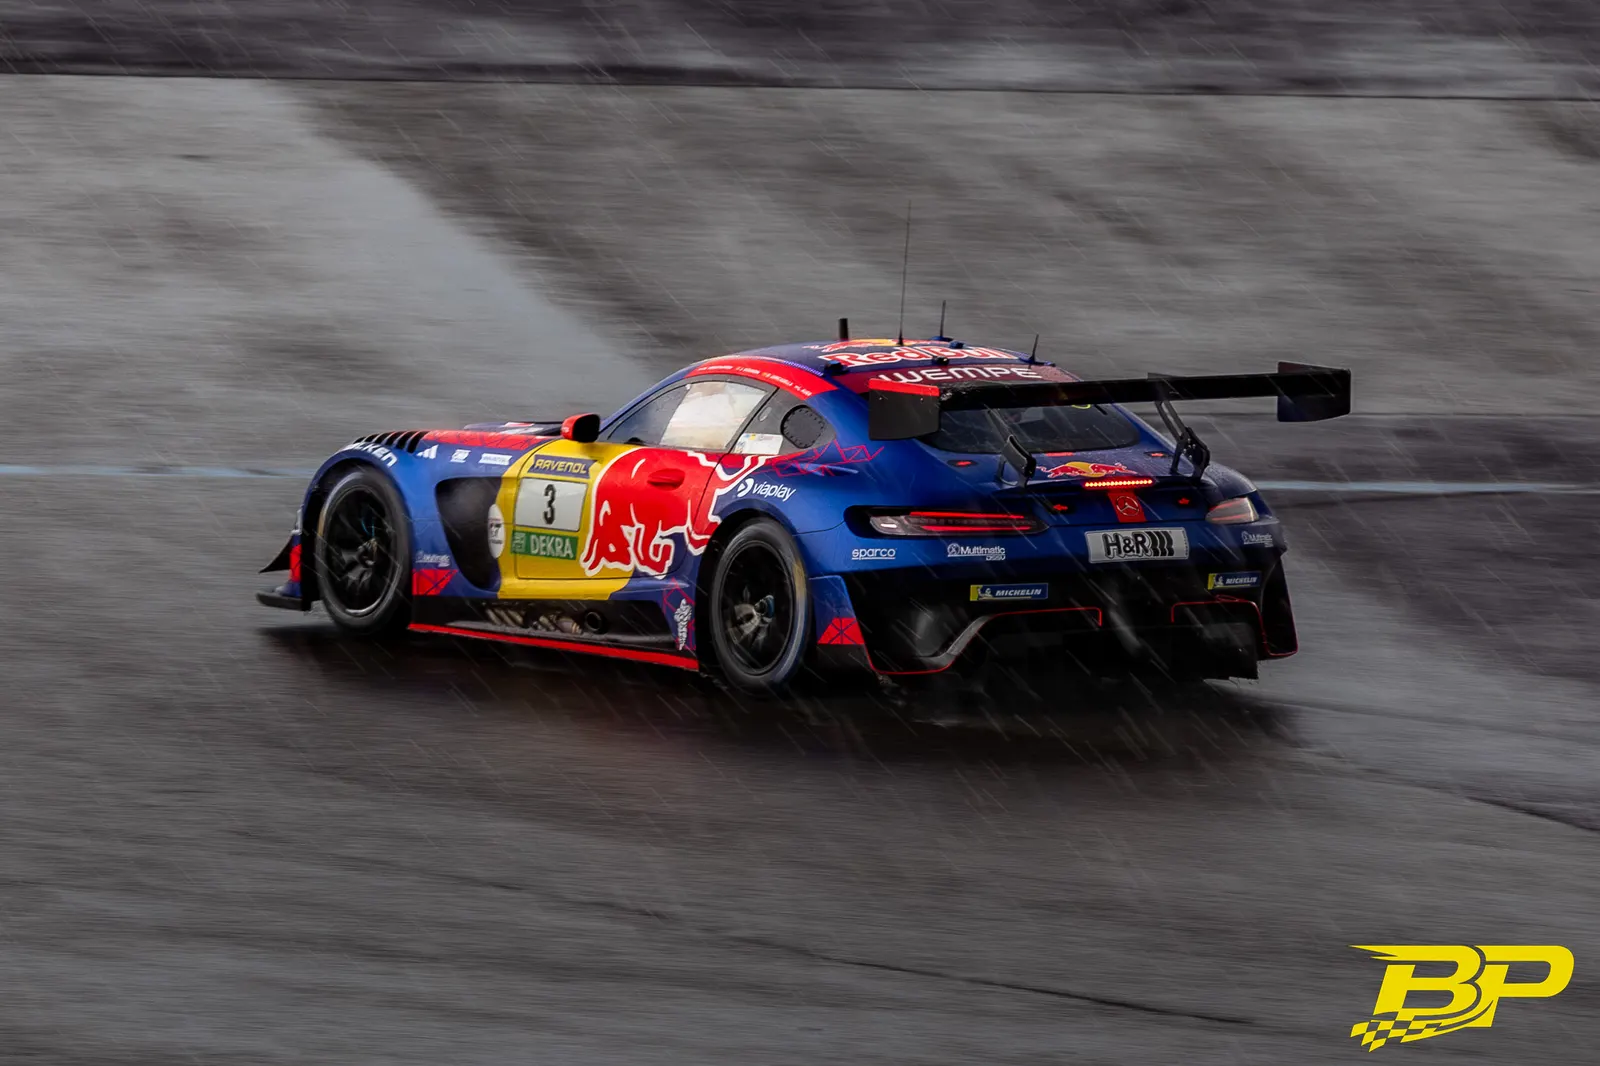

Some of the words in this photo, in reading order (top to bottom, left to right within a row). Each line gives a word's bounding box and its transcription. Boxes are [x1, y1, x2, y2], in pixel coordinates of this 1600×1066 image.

[877, 366, 1042, 383] WEMPE
[534, 459, 587, 474] RAVENOL
[752, 482, 797, 501] viaplay
[543, 484, 556, 525] 3
[529, 534, 574, 558] DEKRA
[851, 548, 896, 560] sparco
[960, 545, 1006, 555] Multimatic
[1102, 532, 1153, 559] H&R
[995, 588, 1042, 597] MICHELIN
